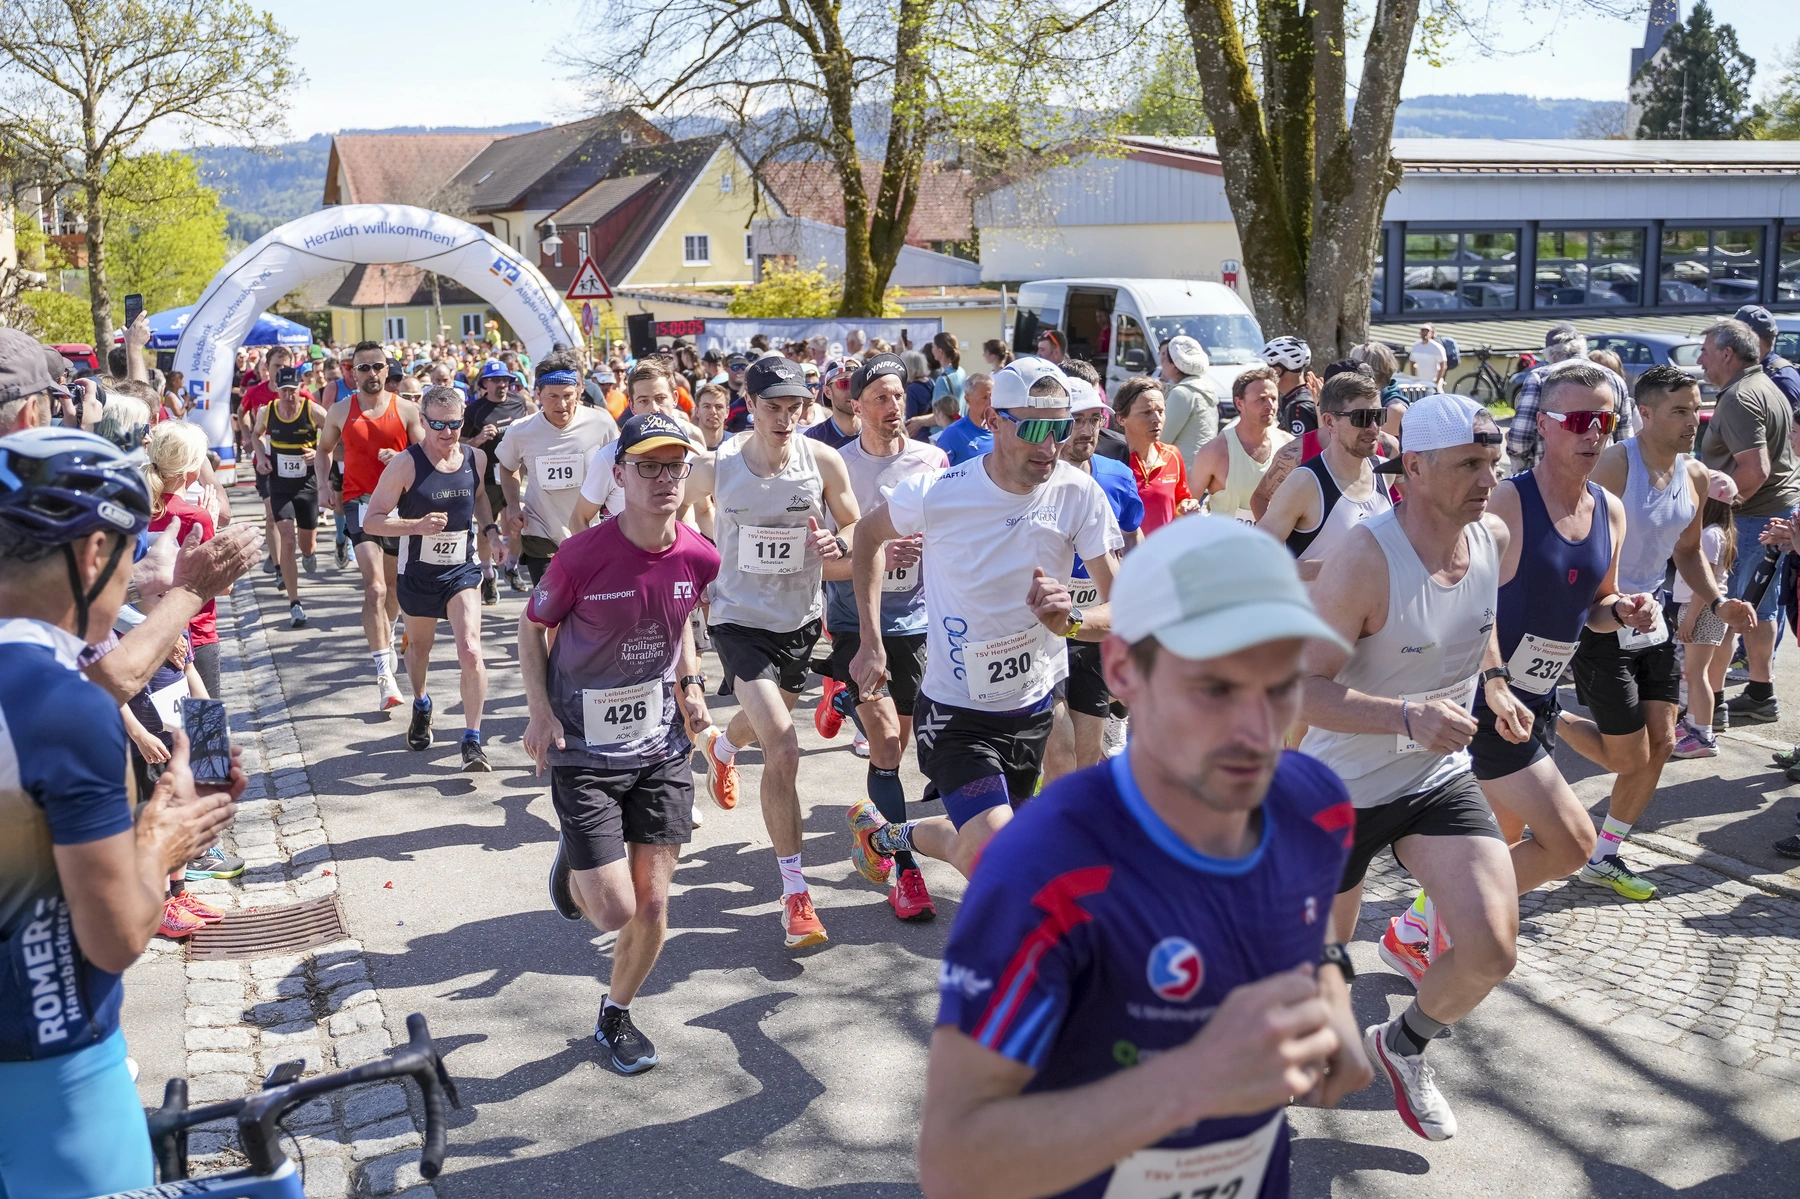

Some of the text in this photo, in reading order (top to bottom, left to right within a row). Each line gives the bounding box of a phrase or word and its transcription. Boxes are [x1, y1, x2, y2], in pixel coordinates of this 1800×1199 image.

[304, 221, 457, 249] Herzlich willkommen!
[524, 279, 559, 320] Volksbank
[516, 287, 560, 344] Allgäu-Obersc
[191, 323, 212, 372] Volksbank
[866, 360, 905, 381] DYNAFIT
[284, 462, 300, 470] 134
[548, 467, 573, 480] 219
[433, 542, 457, 554] 427
[756, 541, 791, 559] 112
[590, 590, 636, 601] INTERSPORT
[621, 640, 666, 653] Trollinger
[986, 634, 1028, 650] Leiblachlauf
[991, 637, 1038, 656] Hergensweiler
[620, 650, 664, 661] Marathon
[988, 652, 1031, 684] 230
[1525, 657, 1563, 680] 232
[604, 686, 644, 698] Leiblachlauf
[608, 690, 654, 704] Hergensweiler
[1425, 684, 1466, 701] Leiblachlauf
[604, 700, 647, 725] 426
[615, 733, 631, 741] AOK
